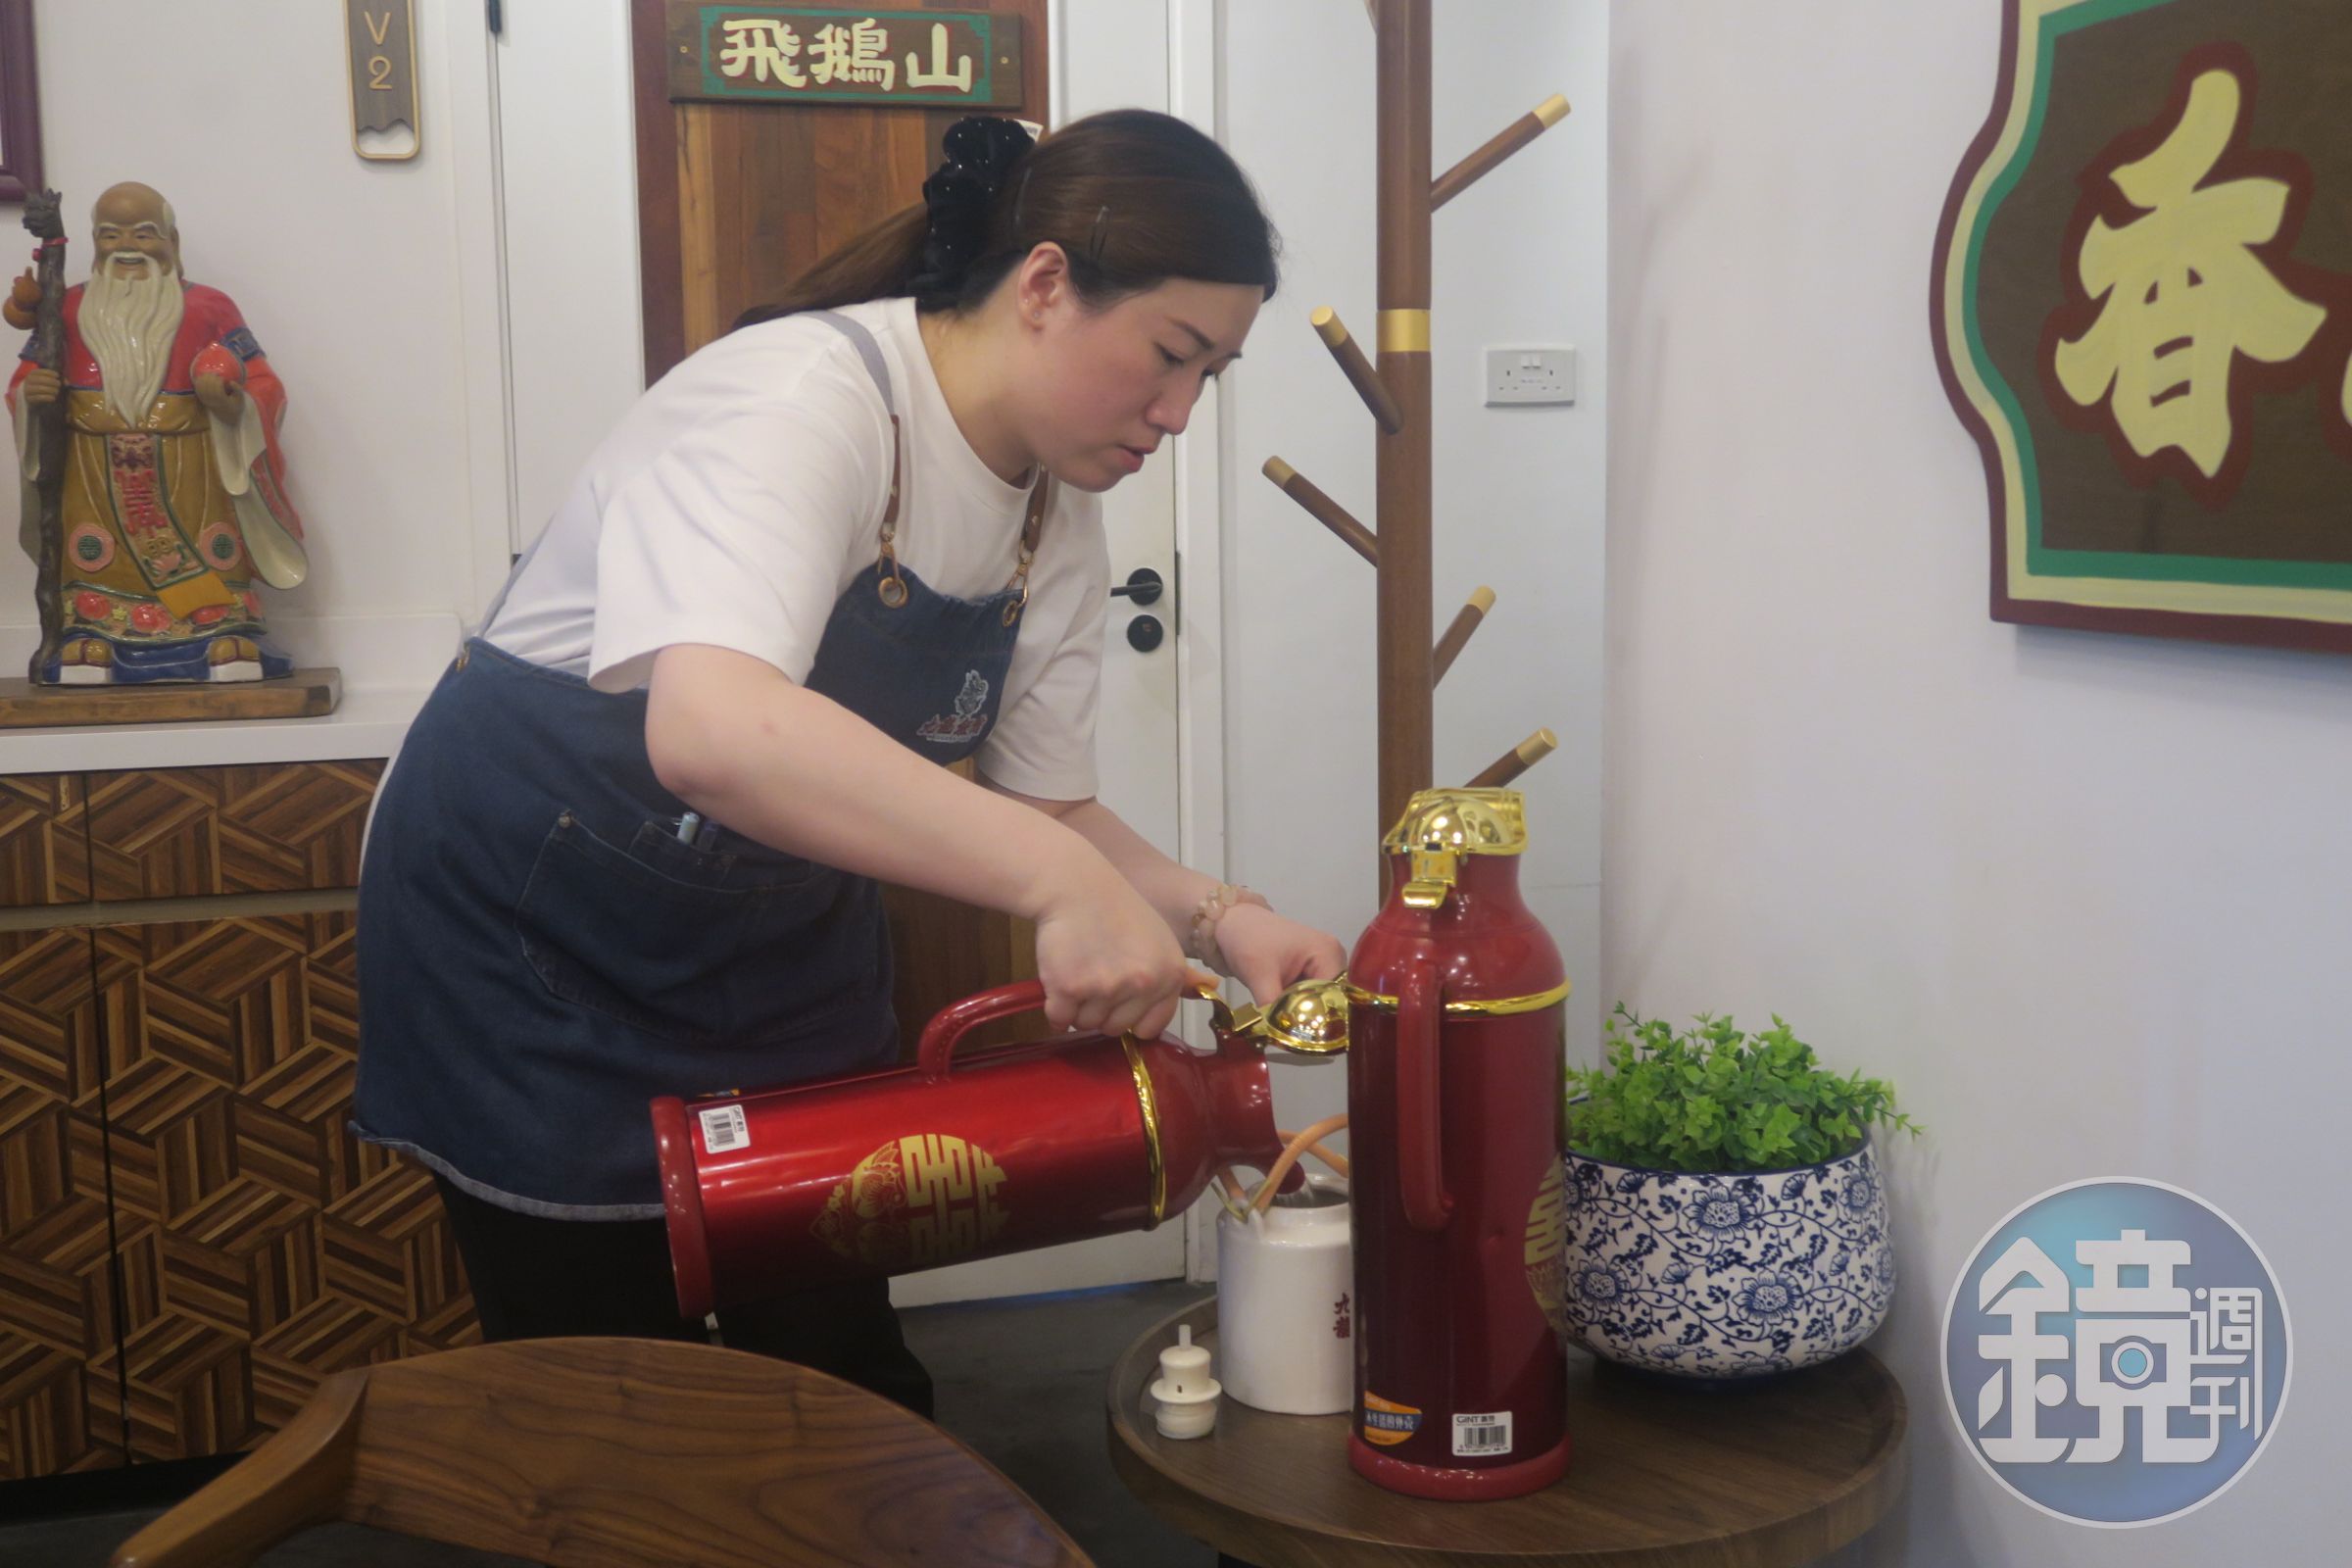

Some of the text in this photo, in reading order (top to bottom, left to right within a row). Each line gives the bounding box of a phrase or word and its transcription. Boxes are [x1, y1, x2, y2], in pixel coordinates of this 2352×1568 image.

[719, 18, 972, 93] 飛鵝山
[2055, 69, 2352, 478] 香
